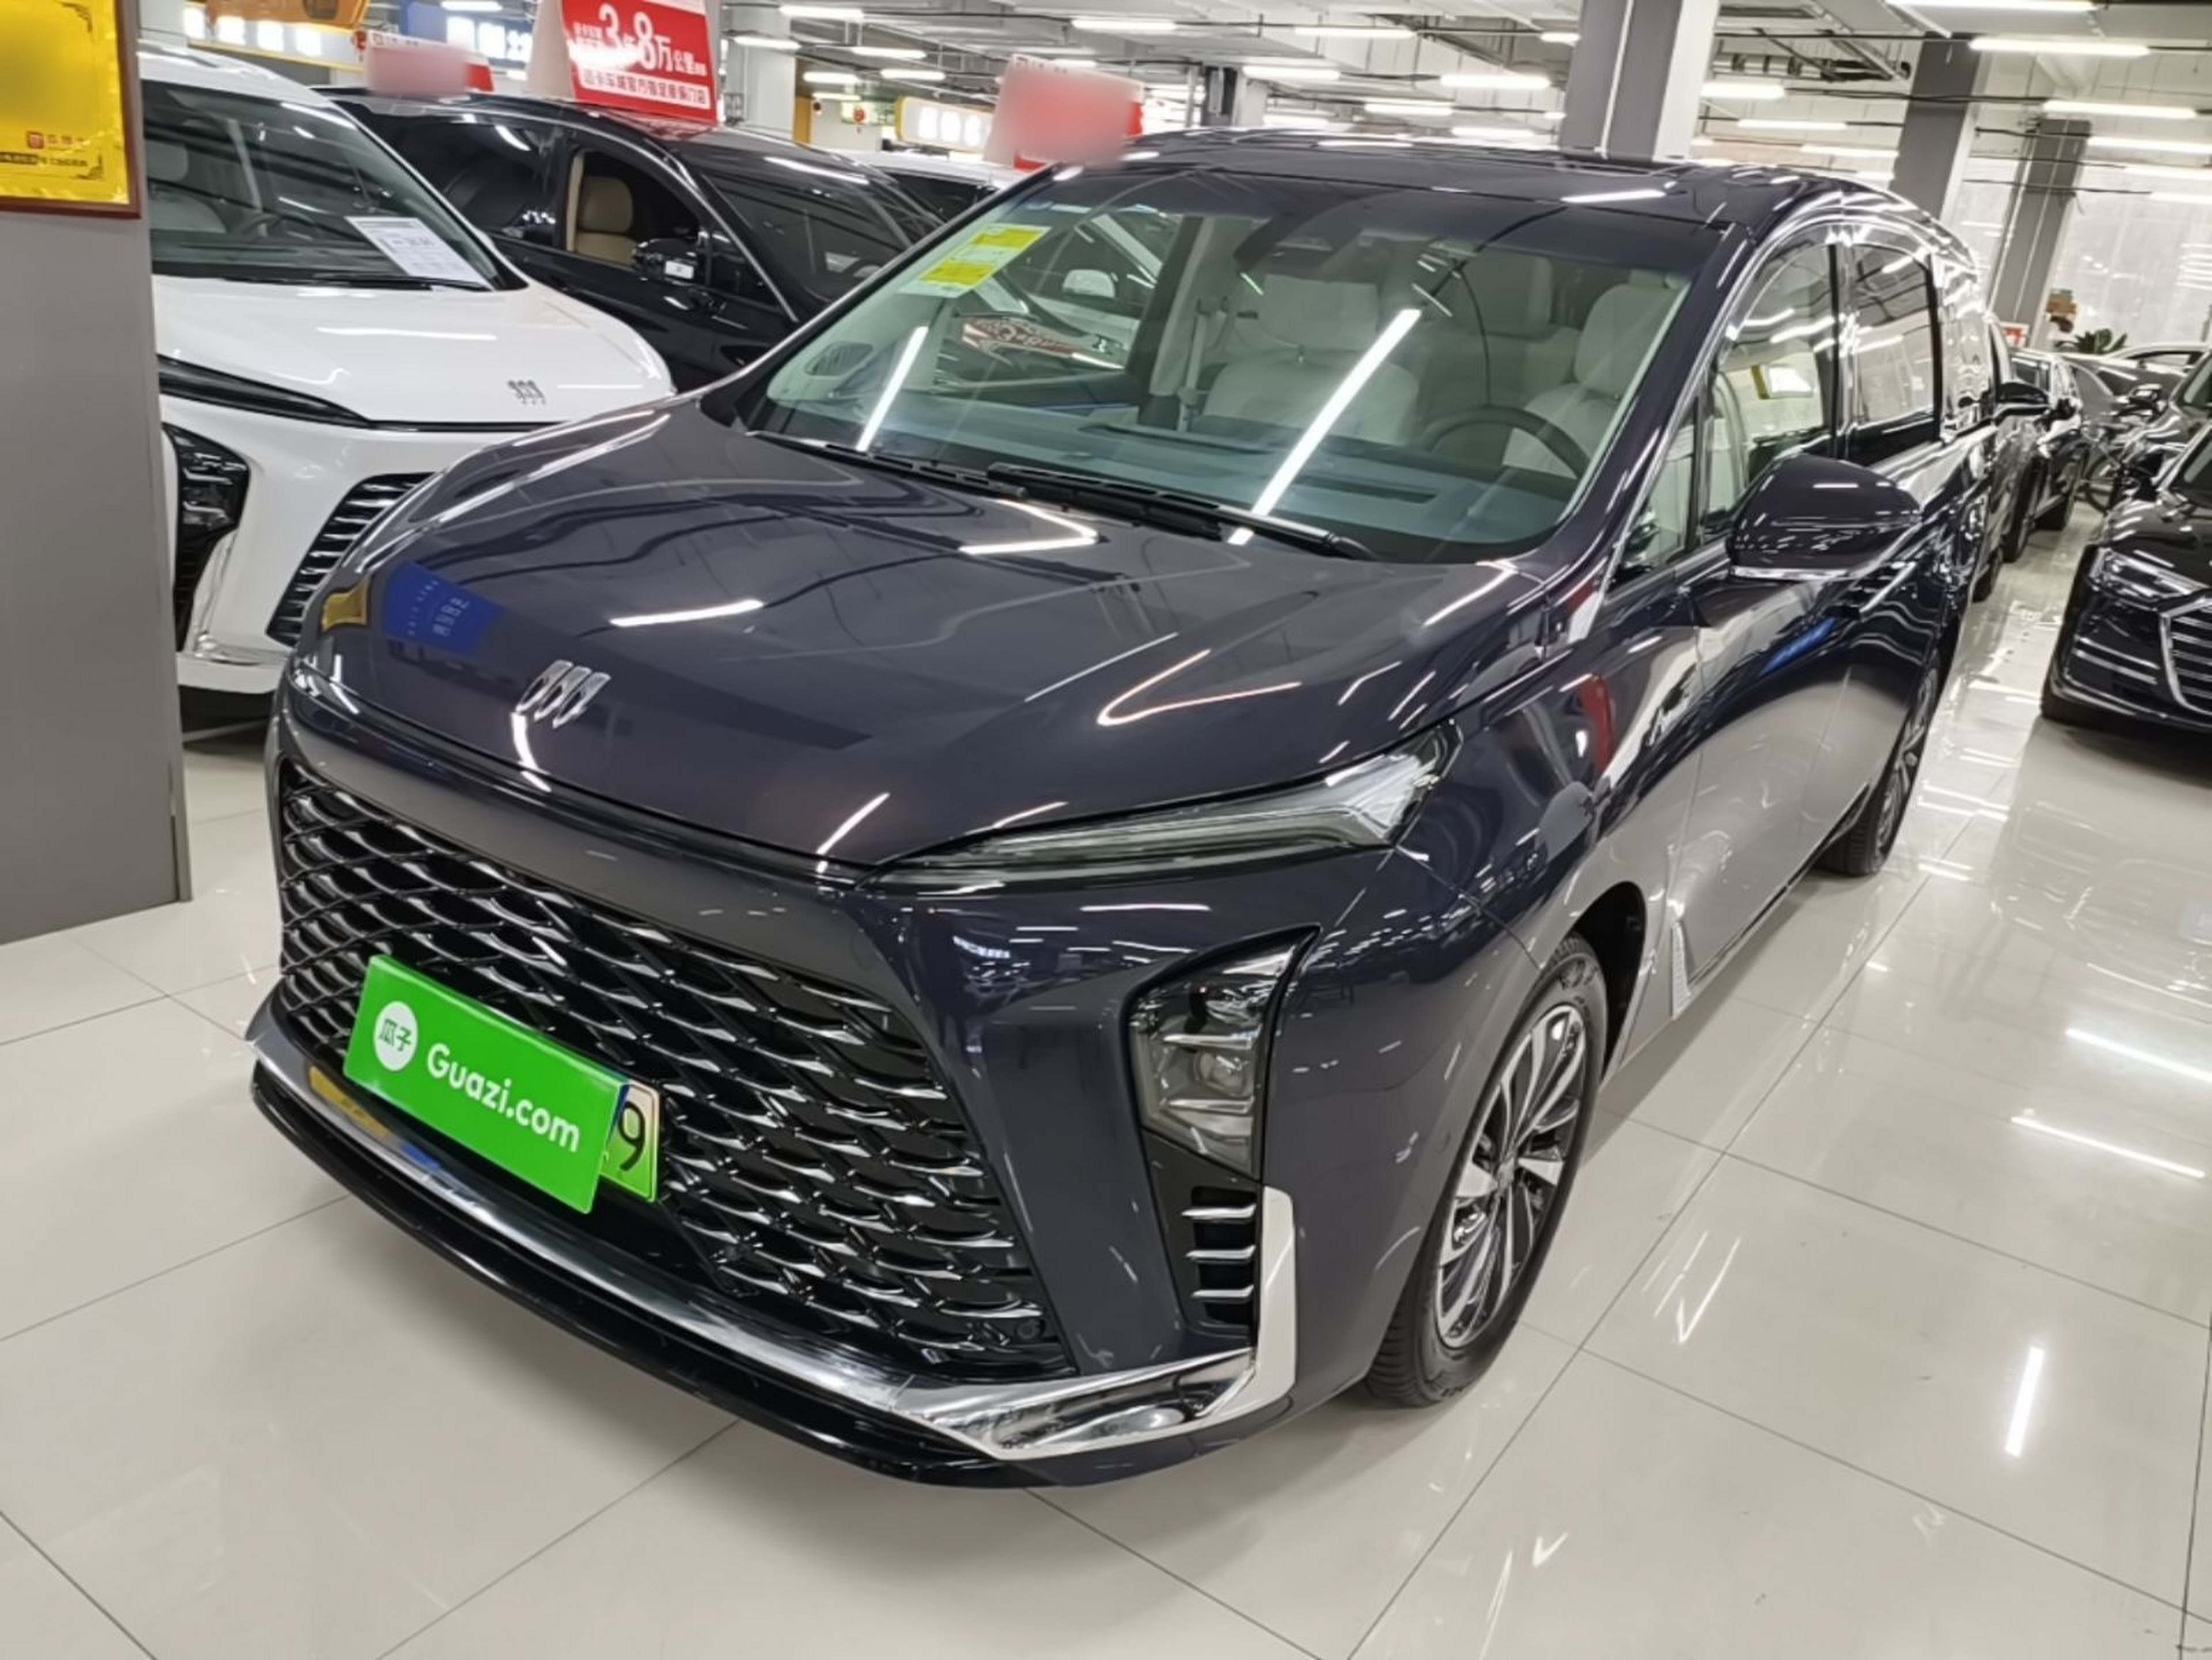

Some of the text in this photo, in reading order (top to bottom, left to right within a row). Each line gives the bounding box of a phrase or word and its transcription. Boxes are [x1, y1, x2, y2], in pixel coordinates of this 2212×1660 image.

[378, 1018, 411, 1052] 瓜子
[427, 1043, 580, 1152] Guazi.com
[618, 1101, 646, 1171] 9
